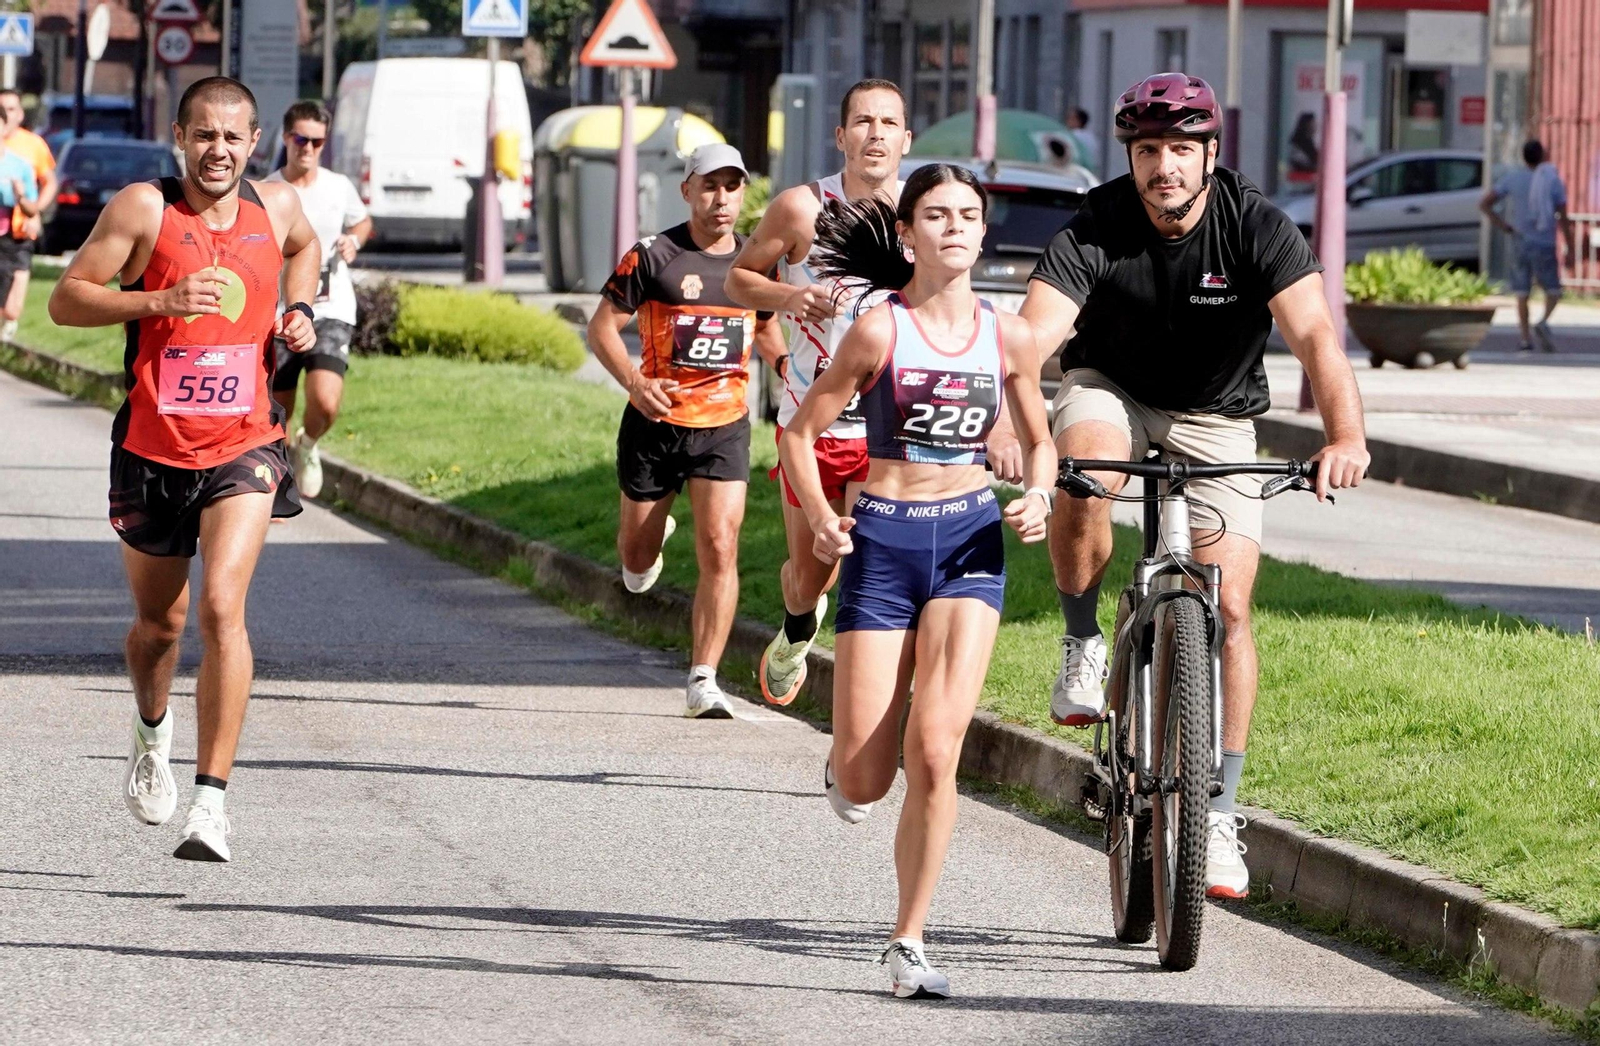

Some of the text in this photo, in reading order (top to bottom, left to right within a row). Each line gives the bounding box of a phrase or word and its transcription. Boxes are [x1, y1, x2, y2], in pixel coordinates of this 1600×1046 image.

[688, 337, 730, 360] 85
[175, 376, 239, 403] 558
[902, 403, 987, 437] 228
[866, 501, 896, 515] PRO
[906, 505, 940, 517] NIKE
[942, 500, 968, 515] PRO
